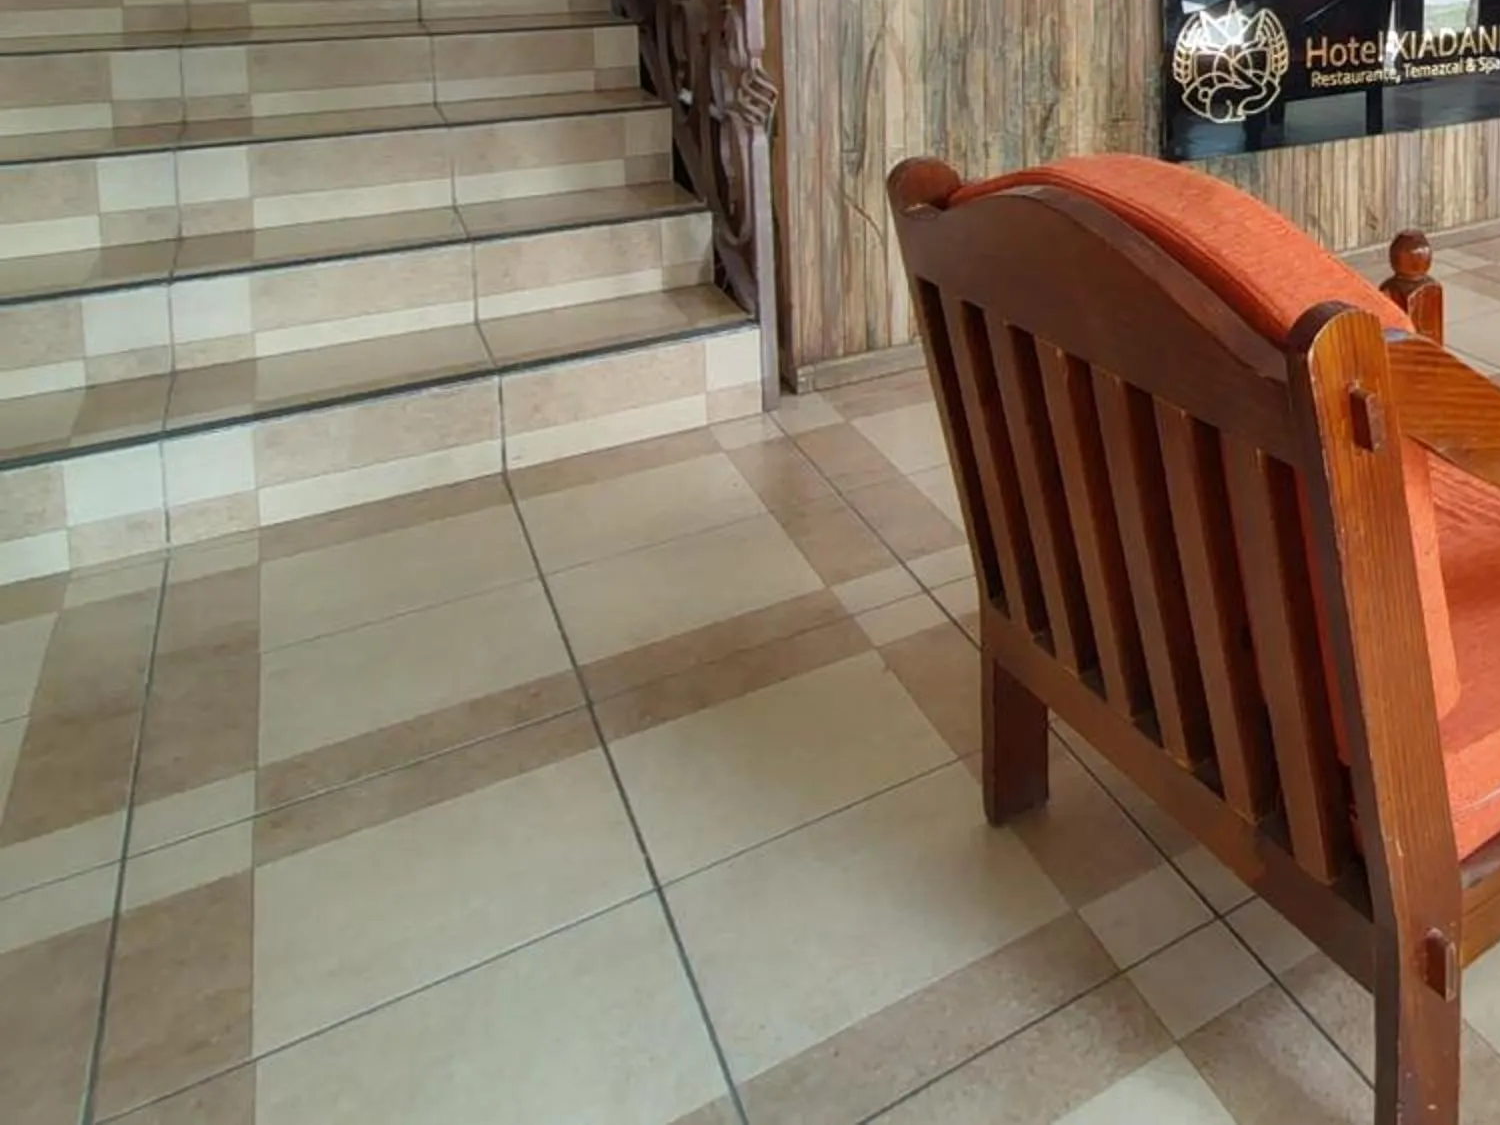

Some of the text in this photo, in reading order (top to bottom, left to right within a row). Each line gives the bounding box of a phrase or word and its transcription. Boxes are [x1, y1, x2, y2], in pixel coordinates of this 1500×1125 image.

[1305, 31, 1384, 68] Hotel
[1404, 58, 1463, 78] Temazcal
[1465, 58, 1476, 72] &
